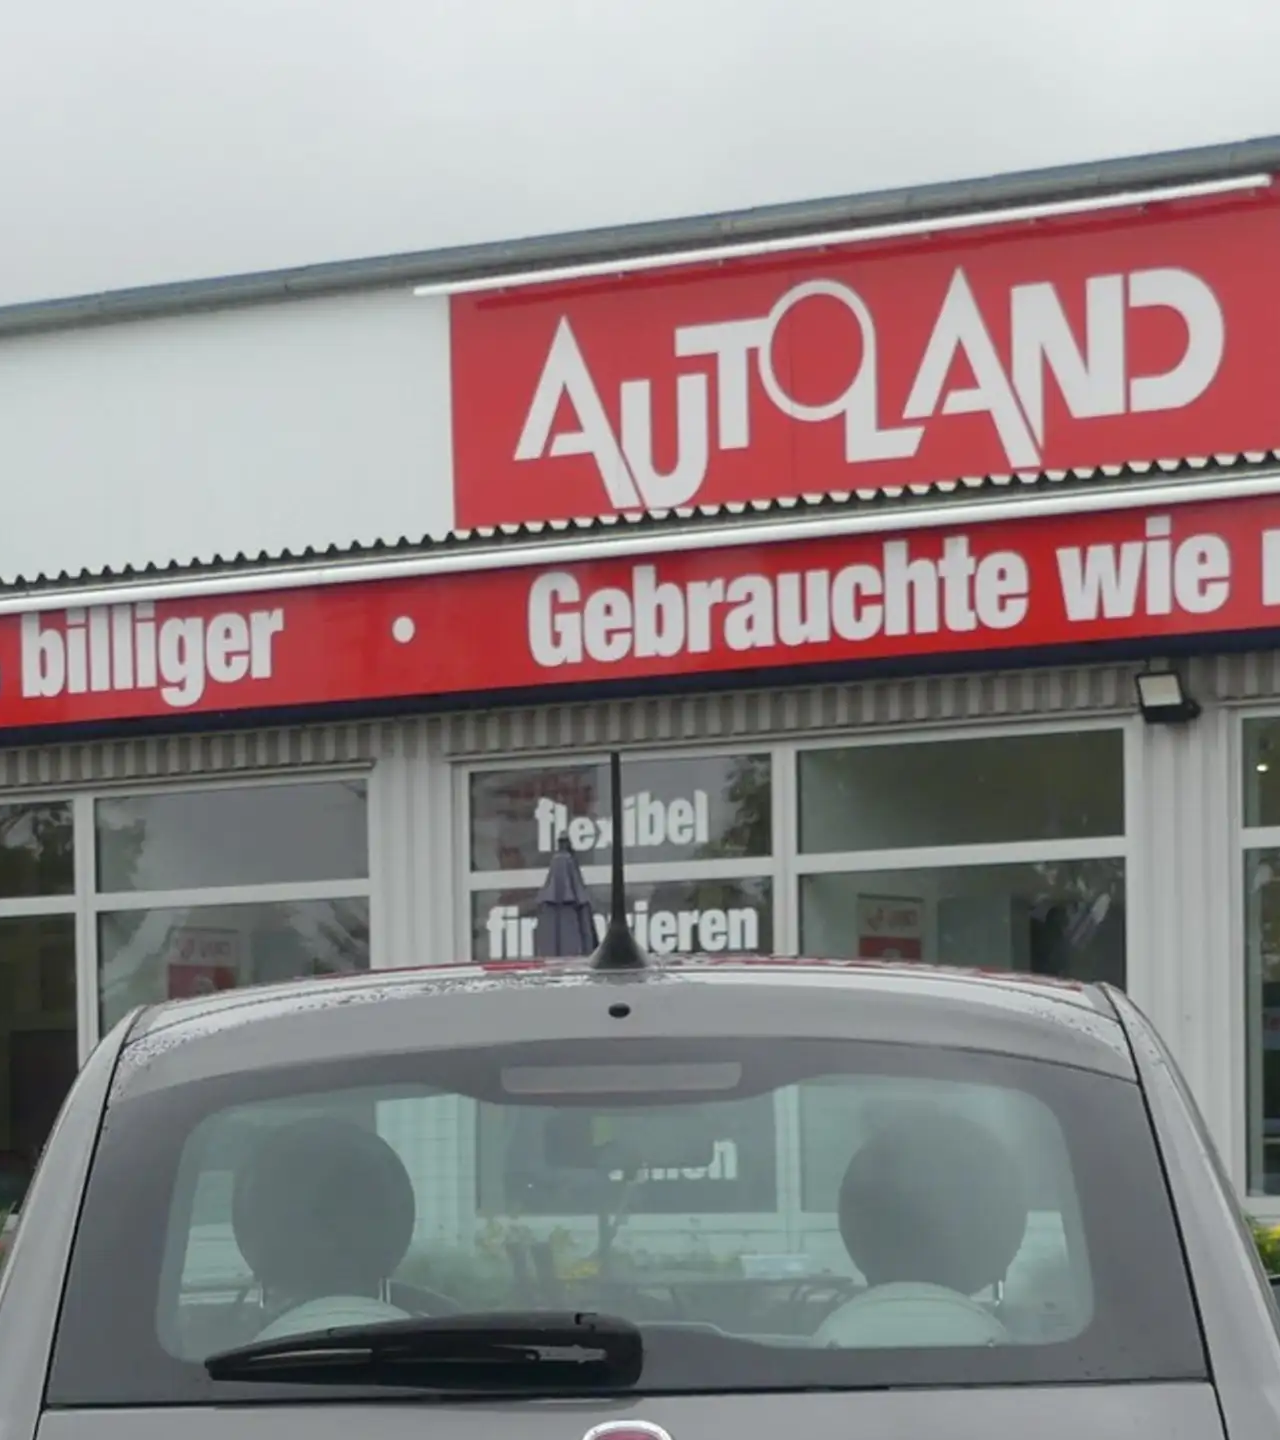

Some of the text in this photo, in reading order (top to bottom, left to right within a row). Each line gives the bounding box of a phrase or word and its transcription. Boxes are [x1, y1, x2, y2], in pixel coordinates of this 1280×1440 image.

[513, 266, 1225, 512] AUTOLAND
[21, 601, 285, 708] billiger
[527, 535, 1030, 668] Gebrauchte
[1056, 515, 1231, 623] wie
